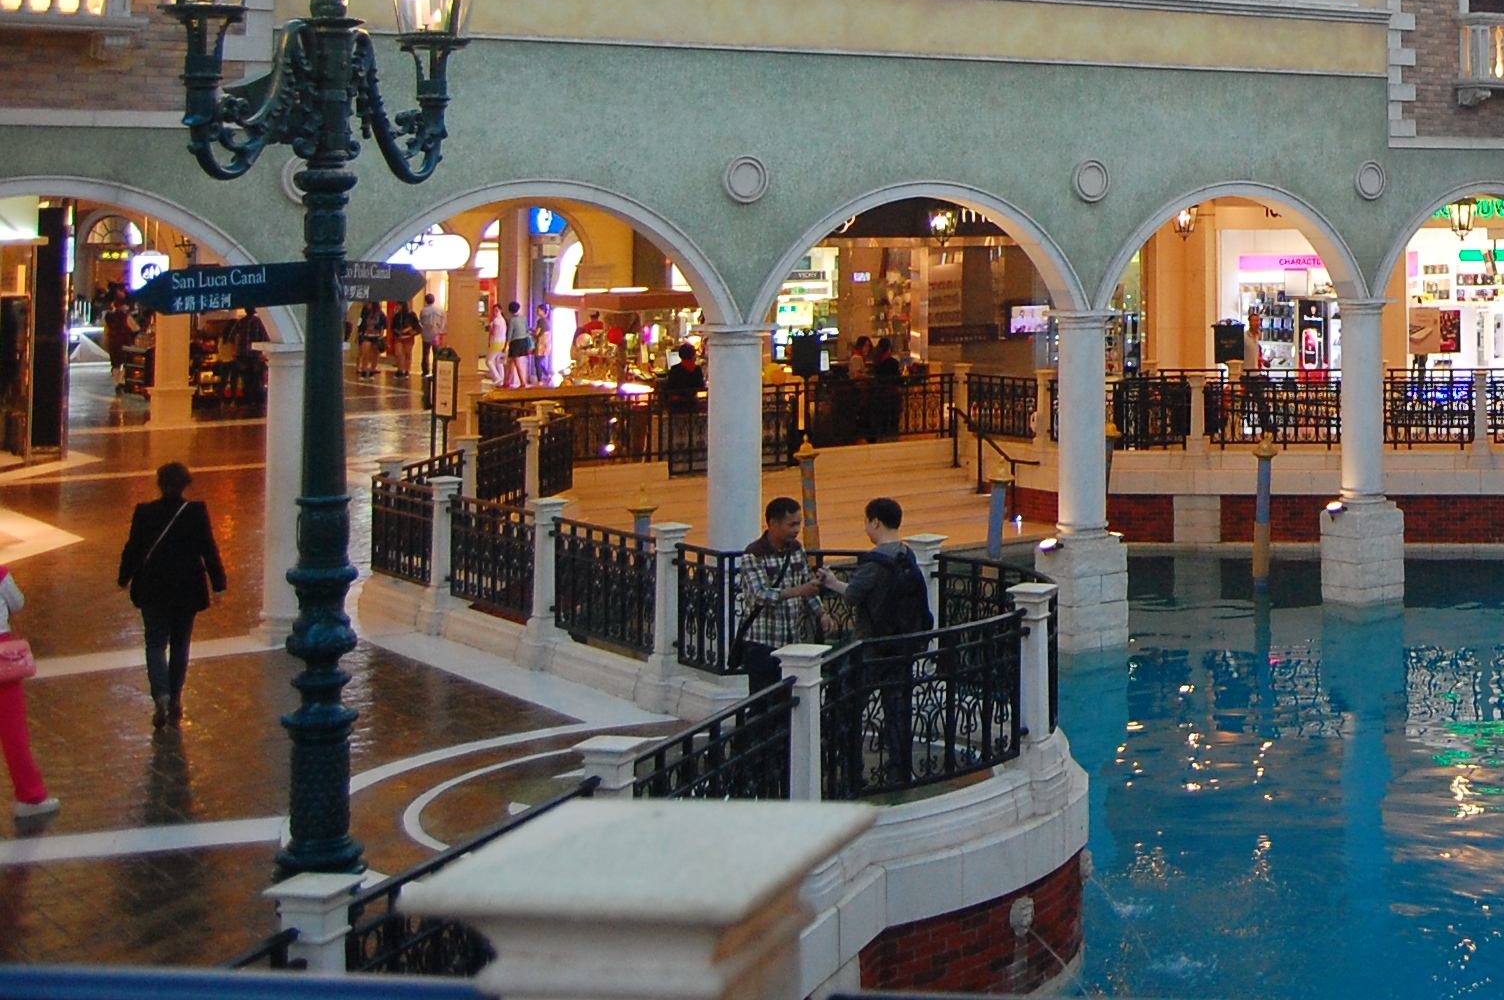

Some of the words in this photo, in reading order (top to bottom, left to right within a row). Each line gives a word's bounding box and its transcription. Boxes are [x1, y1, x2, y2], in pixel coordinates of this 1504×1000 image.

[172, 272, 195, 290] San
[199, 271, 227, 288] Luca
[230, 266, 266, 285] Canal
[370, 264, 391, 279] Canal
[173, 292, 232, 311] 圣路卡运河
